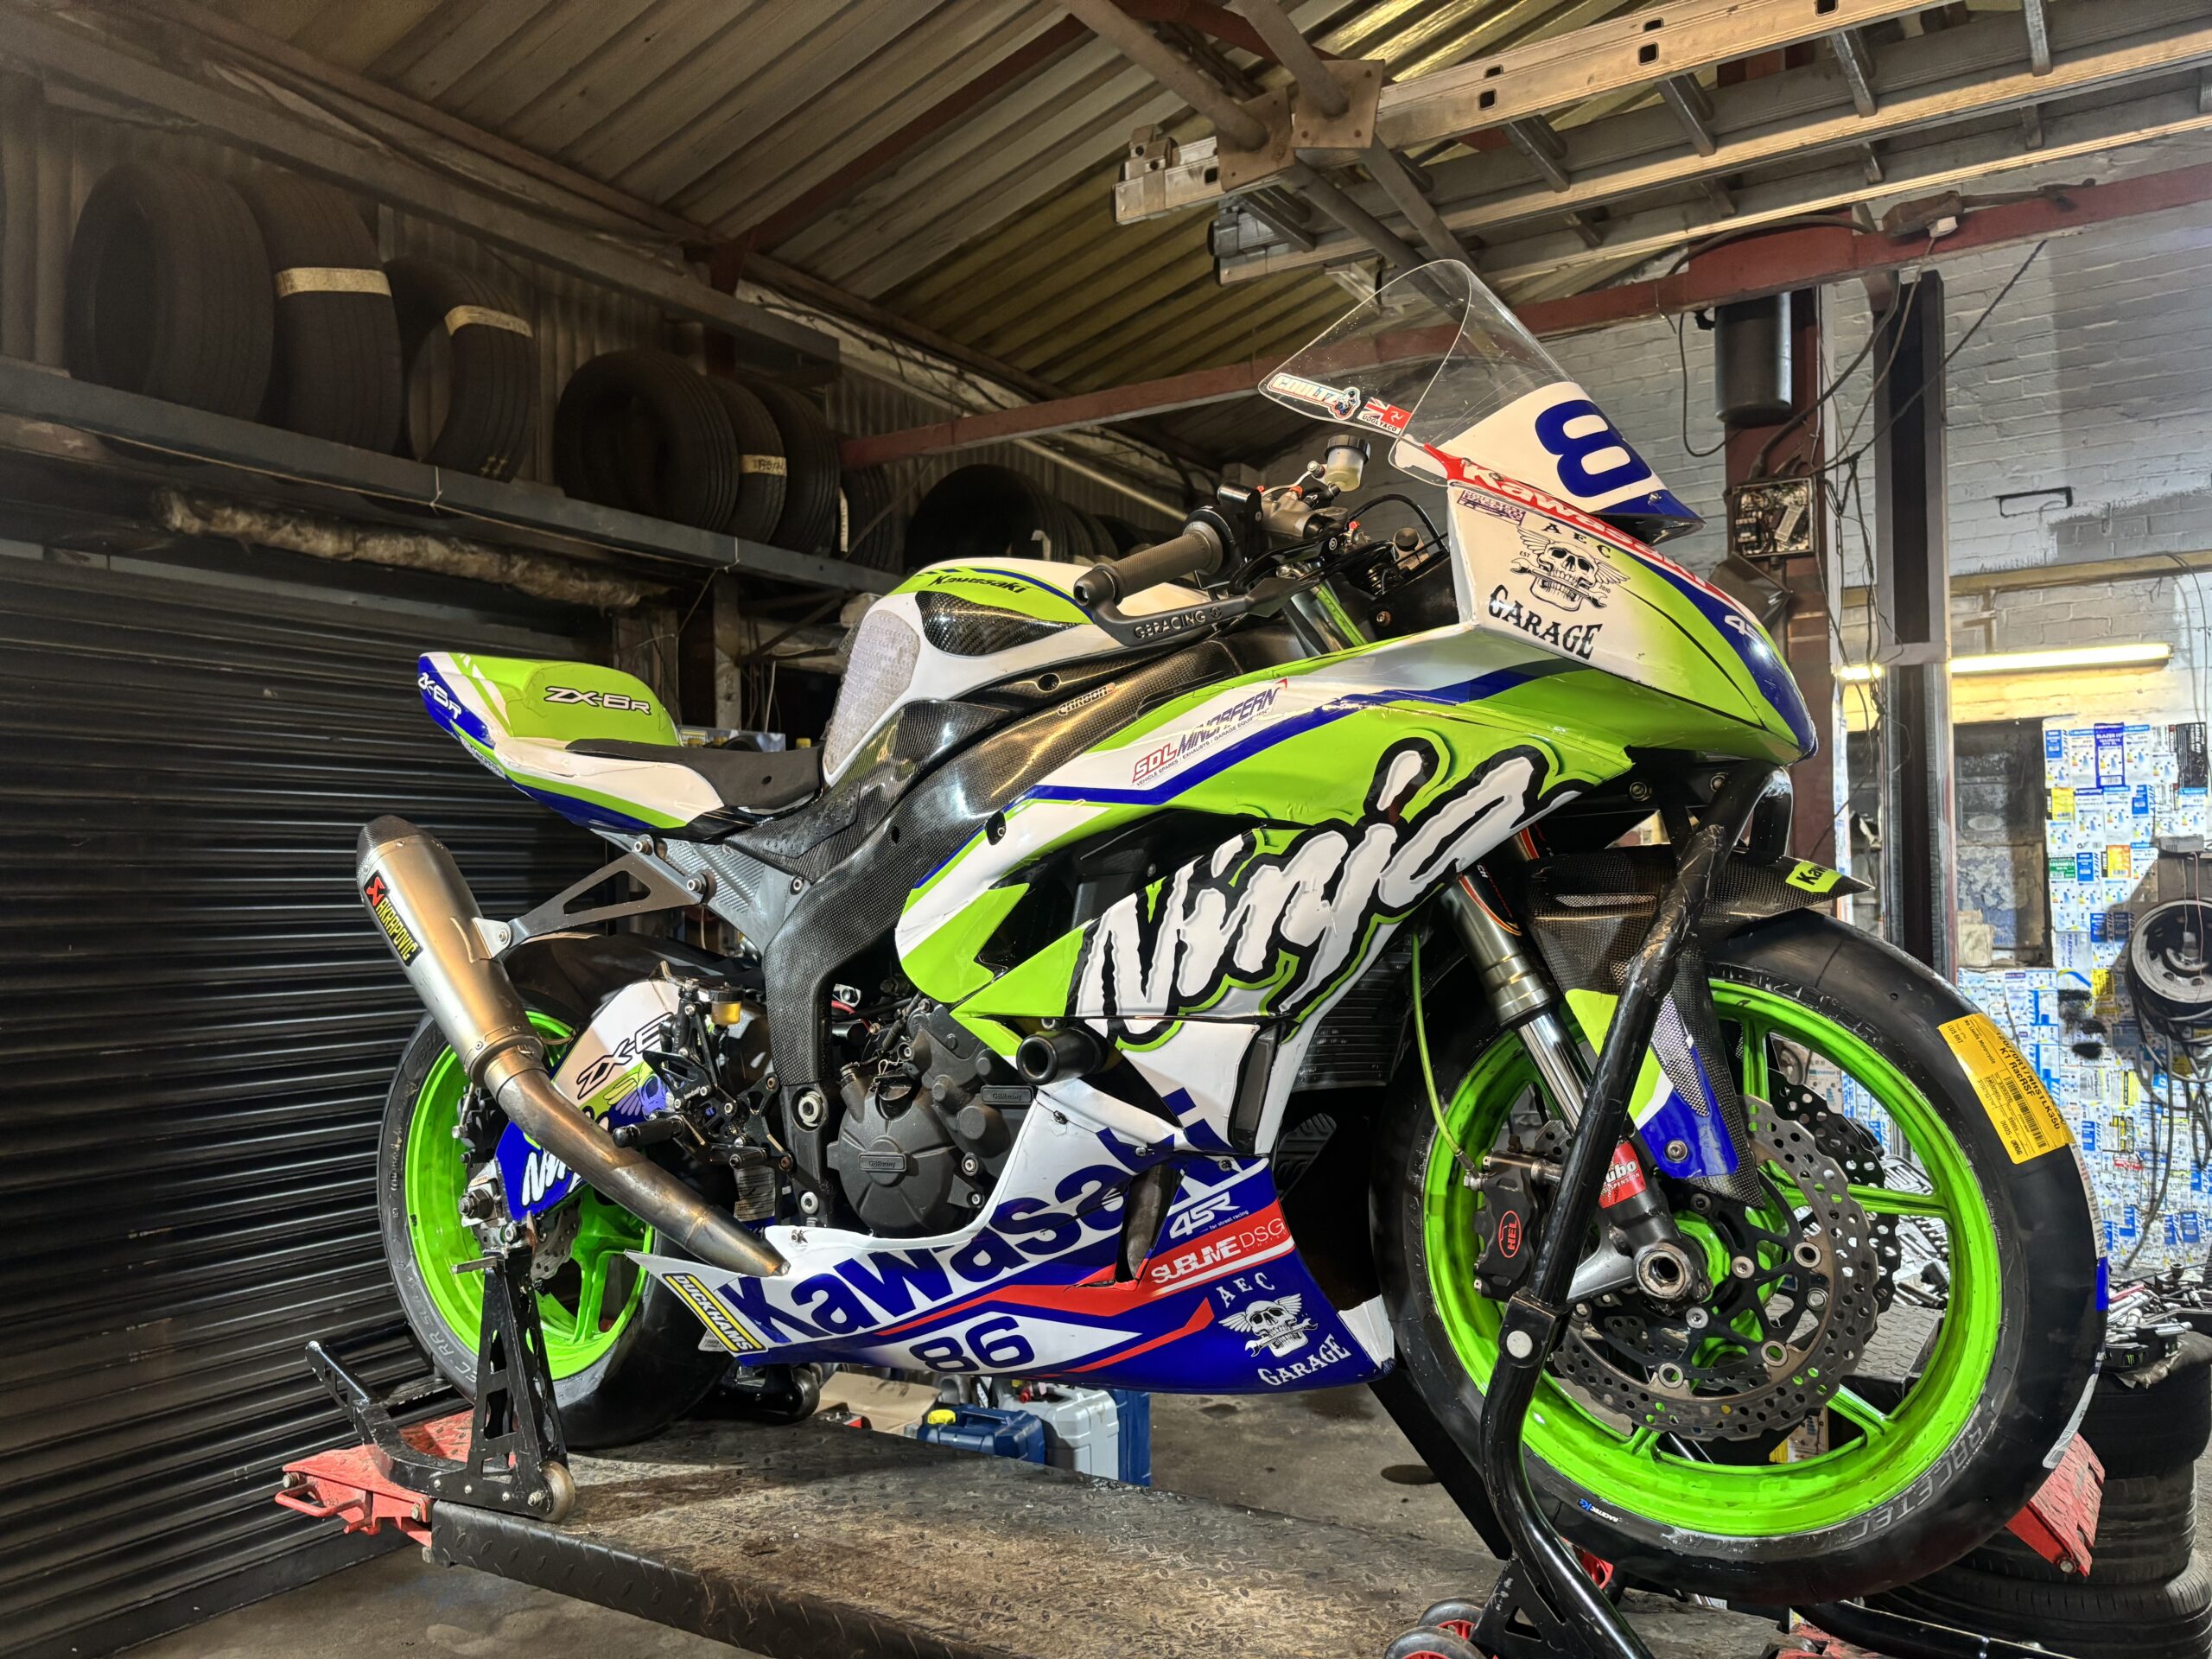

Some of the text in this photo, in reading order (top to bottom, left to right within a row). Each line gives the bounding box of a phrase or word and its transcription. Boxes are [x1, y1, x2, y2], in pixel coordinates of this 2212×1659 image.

[1535, 399, 1652, 497] 8
[927, 575, 1030, 594] Kawasaki
[1599, 584, 1611, 594] 2010
[1489, 584, 1603, 660] GARAGE
[543, 685, 652, 715] ZX-6R
[1132, 743, 1177, 783] SDL
[1136, 772, 1158, 786] VEHICLE
[1158, 759, 1179, 775] SPARES
[1182, 741, 1210, 760] EXHAUSTS
[1214, 726, 1236, 741] GARAGE
[1076, 750, 1583, 1035] Ninja
[1999, 1047, 2011, 1059] K1
[2008, 1061, 2036, 1097] RacRSF
[1169, 1191, 1241, 1239] 4SR
[1217, 1216, 1233, 1227] street
[1232, 1210, 1249, 1222] racing
[1239, 1217, 1286, 1249] DSG
[1507, 1219, 1518, 1251] HEL
[671, 1274, 753, 1351] DUCKHAMS
[908, 1316, 1035, 1374] 86
[1257, 1333, 1352, 1386] GARAGE
